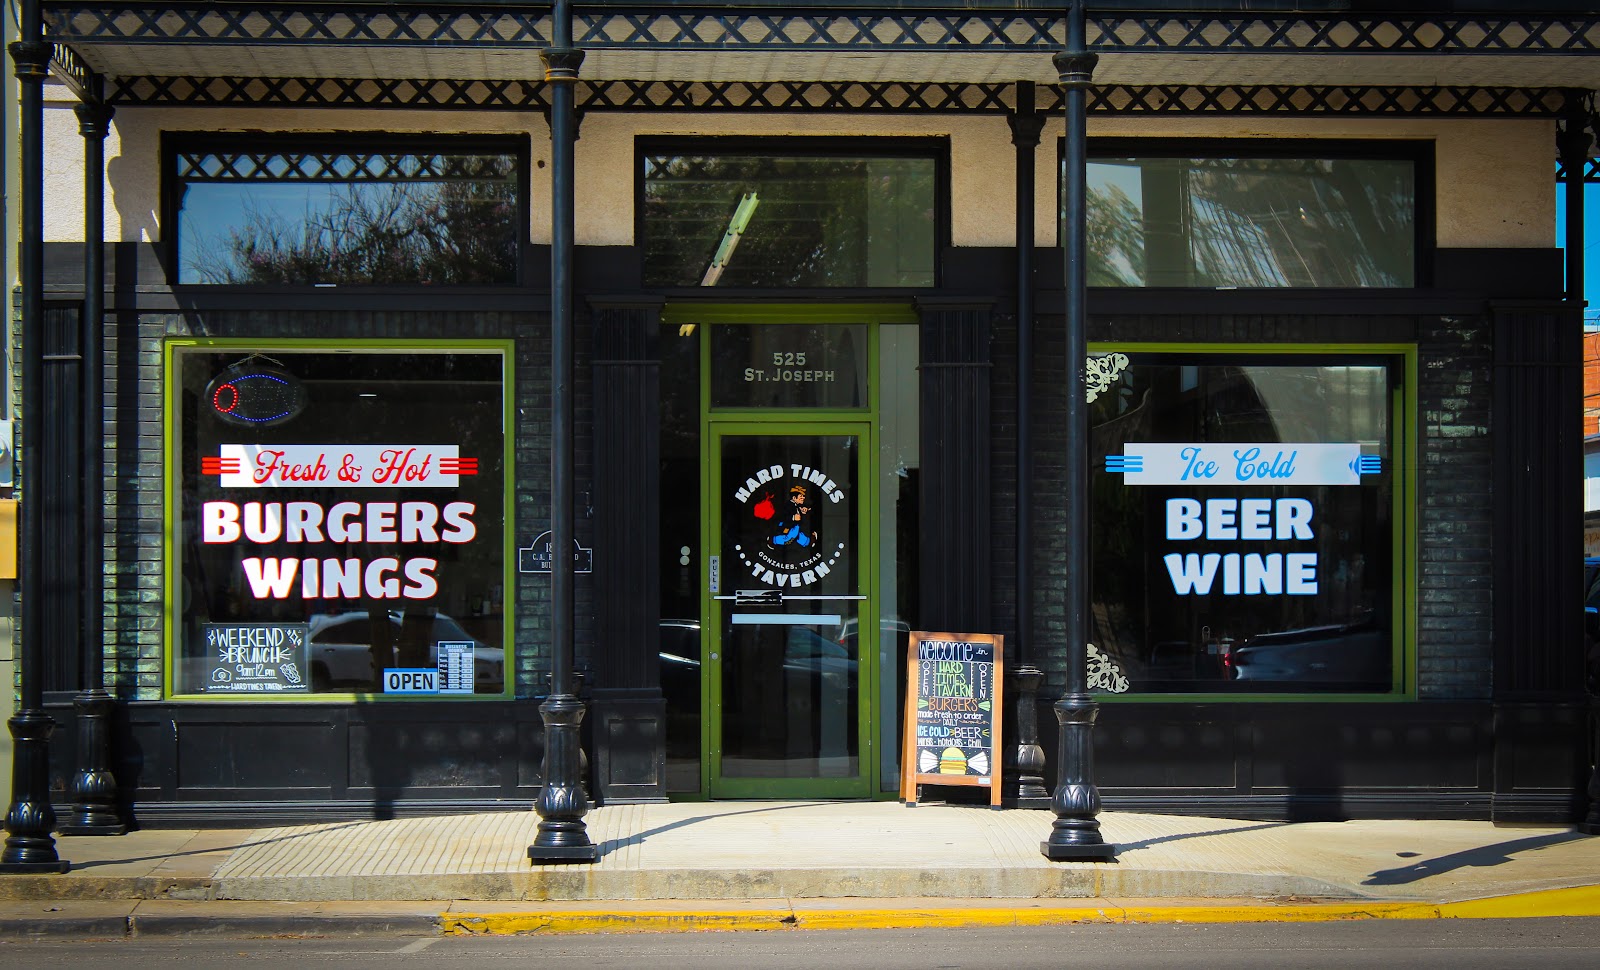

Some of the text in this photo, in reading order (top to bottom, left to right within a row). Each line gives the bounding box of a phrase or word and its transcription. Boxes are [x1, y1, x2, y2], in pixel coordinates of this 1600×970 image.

[773, 352, 806, 366] 525
[253, 447, 432, 484] Fresh & Hot
[1180, 447, 1297, 481] Ice Cold
[734, 463, 845, 504] HARD TIMES
[202, 501, 477, 545] BURGERS
[1164, 497, 1315, 541] BEER
[799, 552, 822, 569] TEXAS
[241, 557, 439, 600] WINGS
[751, 561, 831, 588] TAVERN
[1163, 552, 1319, 596] WINE
[216, 628, 284, 647] WEEKEND
[228, 646, 281, 664] BRUNCH
[919, 641, 989, 661] Welcome in
[939, 661, 963, 674] HARD
[389, 673, 433, 690] OPEN
[922, 661, 931, 696] OPEN
[936, 673, 966, 686] TIMES
[978, 663, 988, 699] OPEN
[936, 683, 972, 697] TAVERN
[929, 698, 978, 711] BURGERS
[918, 711, 934, 719] made
[934, 710, 953, 719] fresh
[963, 712, 984, 721] order
[943, 719, 959, 727] DAILY
[918, 725, 983, 739] ICE COLD BEER
